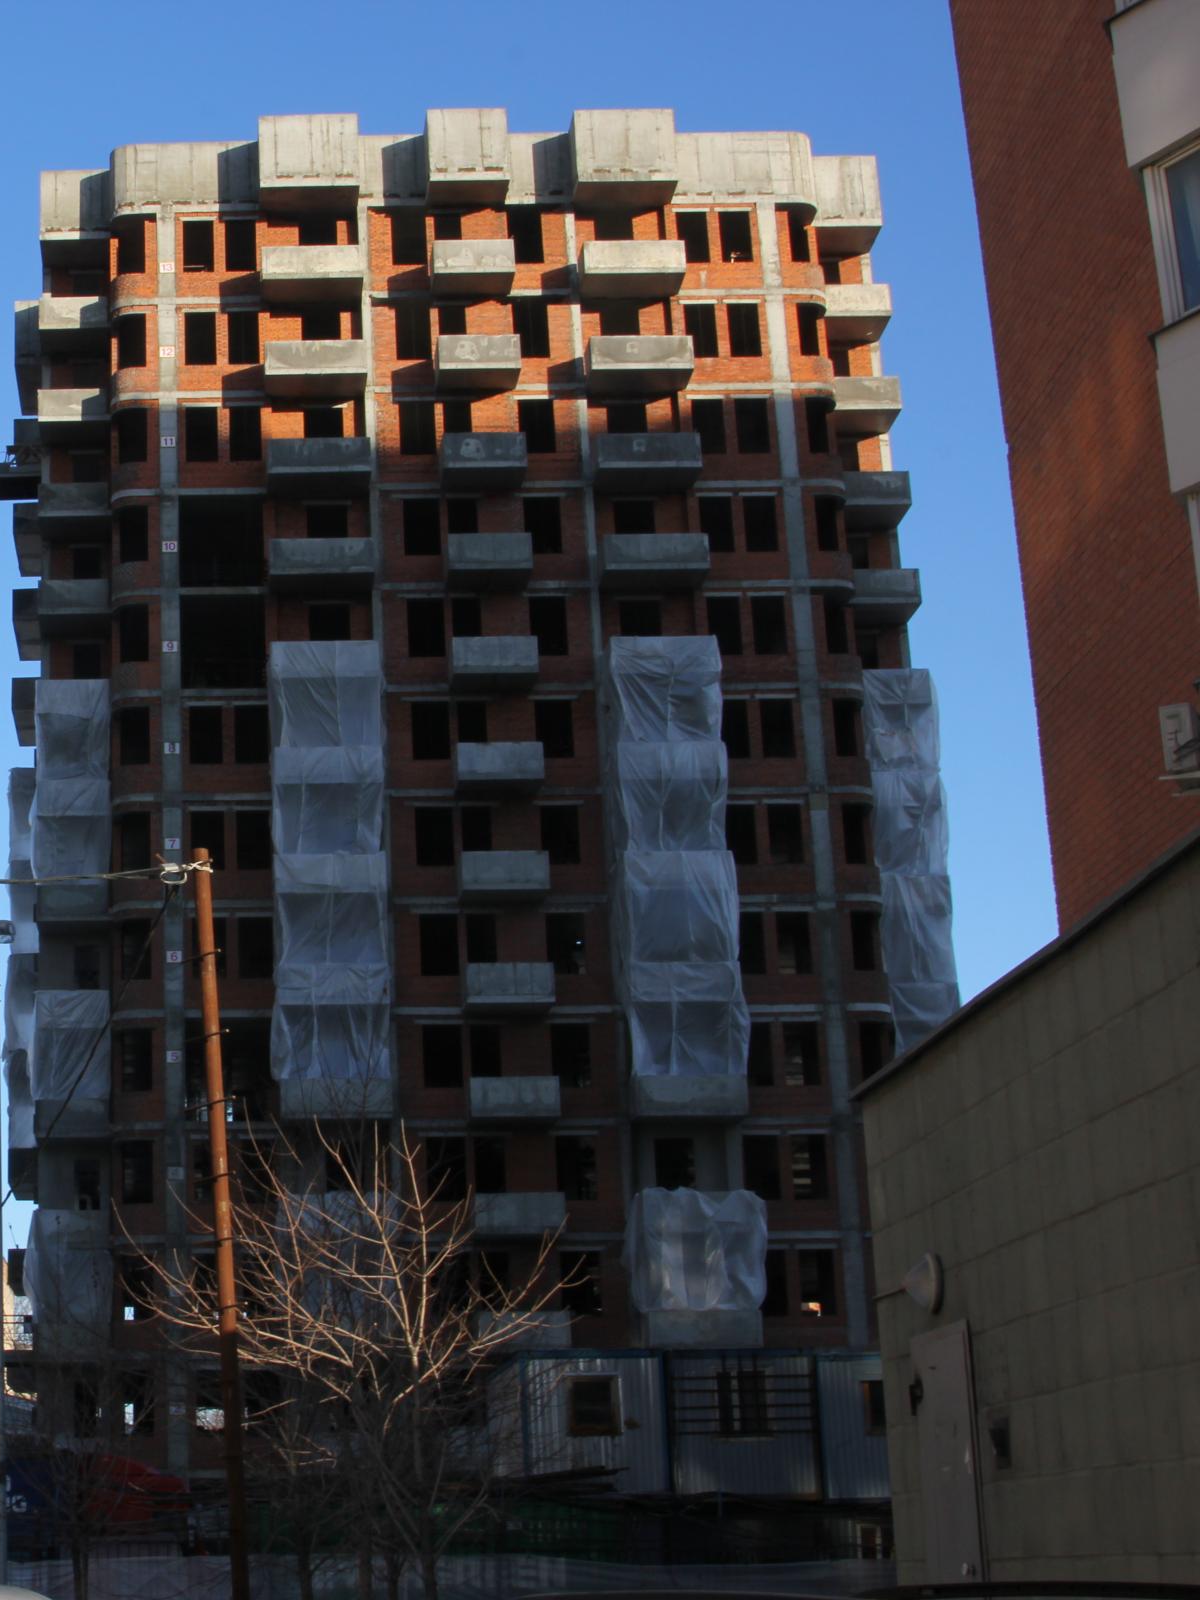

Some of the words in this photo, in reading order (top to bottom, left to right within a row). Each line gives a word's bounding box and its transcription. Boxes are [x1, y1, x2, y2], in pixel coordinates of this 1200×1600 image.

[162, 348, 172, 356] 12
[164, 438, 173, 446] 11
[165, 542, 176, 551] 10
[167, 641, 174, 651] 9
[168, 743, 176, 753] 8
[168, 839, 177, 849] 7
[171, 952, 178, 961] 6
